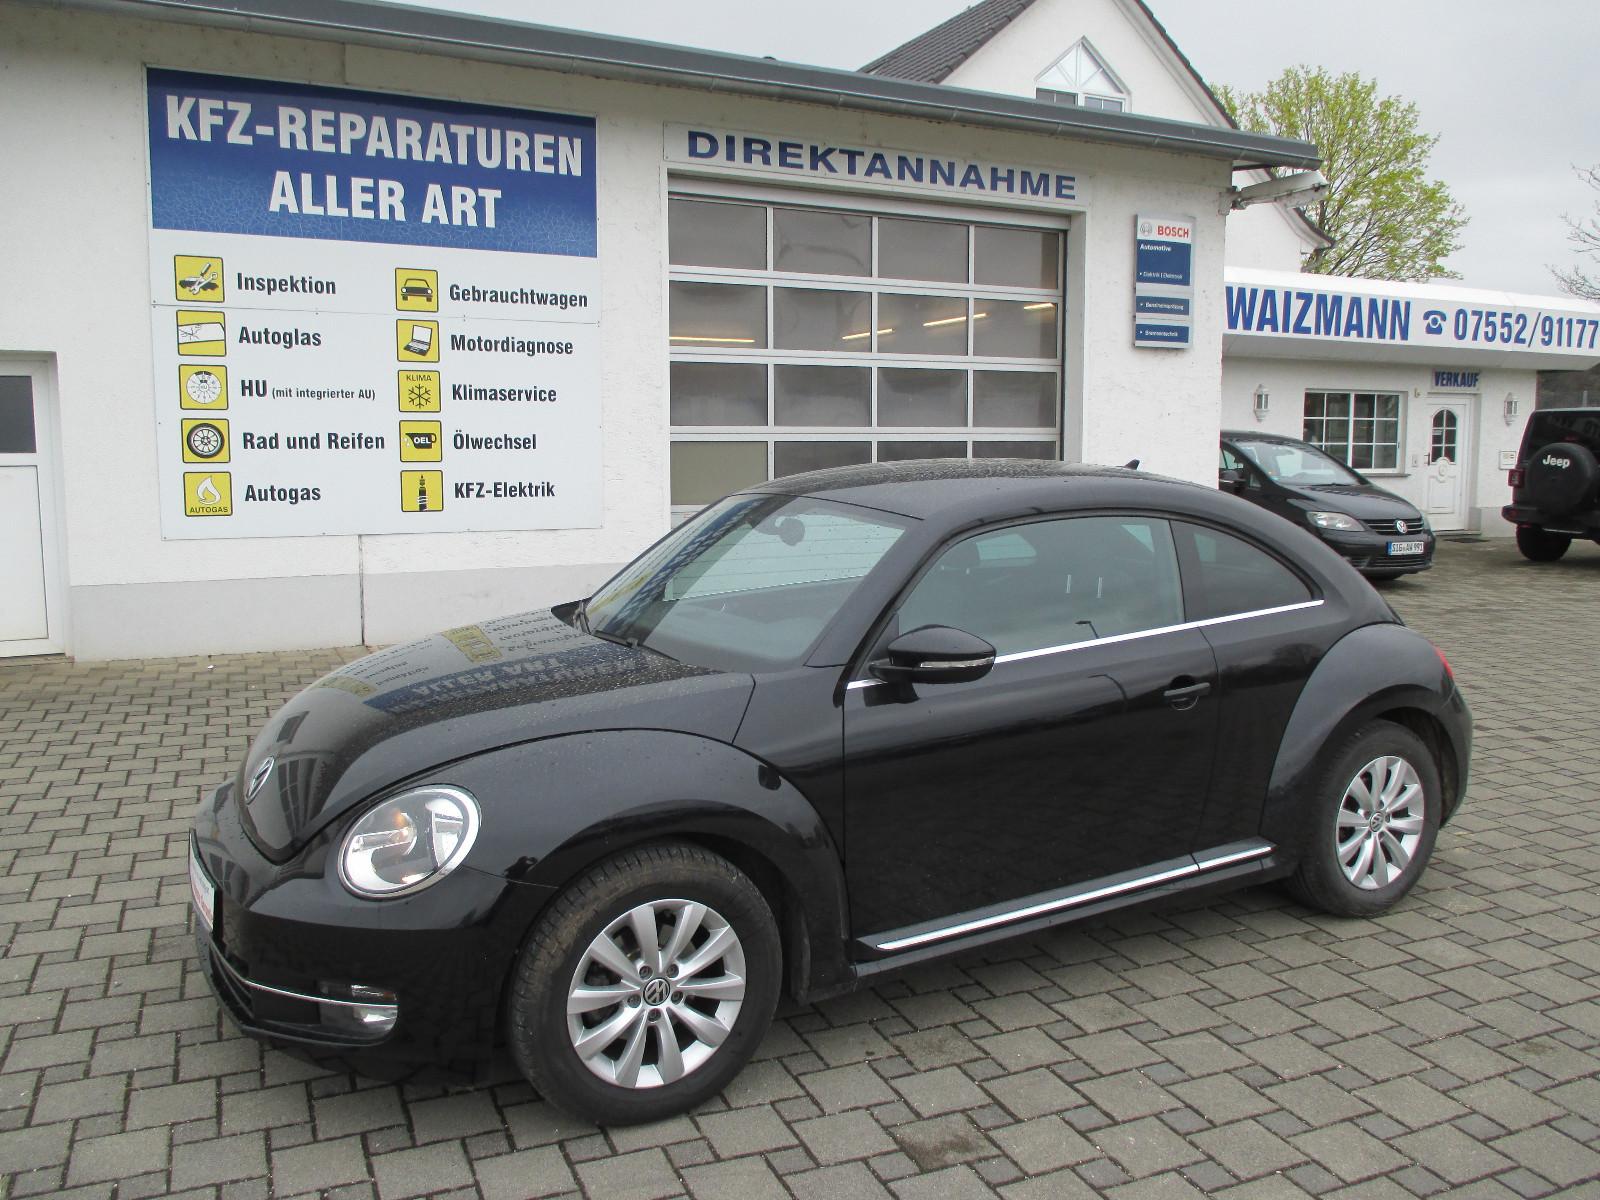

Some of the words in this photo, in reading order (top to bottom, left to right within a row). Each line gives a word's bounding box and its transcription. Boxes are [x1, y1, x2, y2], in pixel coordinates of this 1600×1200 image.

[165, 94, 583, 177] KFZ-REPARATUREN
[687, 130, 1076, 200] DIREKTANNAHME
[268, 170, 407, 223] ALLER
[421, 183, 502, 229] ART
[1157, 225, 1190, 239] BOSCH
[1139, 243, 1172, 253] Automotive
[237, 272, 337, 295] Inspektion
[449, 284, 588, 310] Gebrauchtwagen
[1225, 285, 1412, 341] WAIZMANN
[1453, 308, 1599, 349] 07552/91177
[238, 326, 322, 350] Autoglas
[450, 334, 574, 357] Motordiagnose
[406, 374, 432, 382] KLIMA
[1434, 371, 1480, 388] VERKAUF
[240, 379, 268, 398] HU
[271, 387, 293, 400] (mit
[296, 388, 355, 401] integrierter
[358, 389, 376, 401] AU)
[452, 384, 557, 402] Klimaservice
[242, 432, 279, 450] Rad
[286, 432, 321, 450] und
[328, 432, 385, 450] Reifen
[413, 437, 431, 445] OEL
[453, 430, 537, 450] Ölwechsel
[1542, 454, 1571, 469] Jeep
[244, 484, 322, 505] Autogas
[454, 482, 556, 499] KFZ-Elektrik
[189, 506, 229, 514] AUTOGAS
